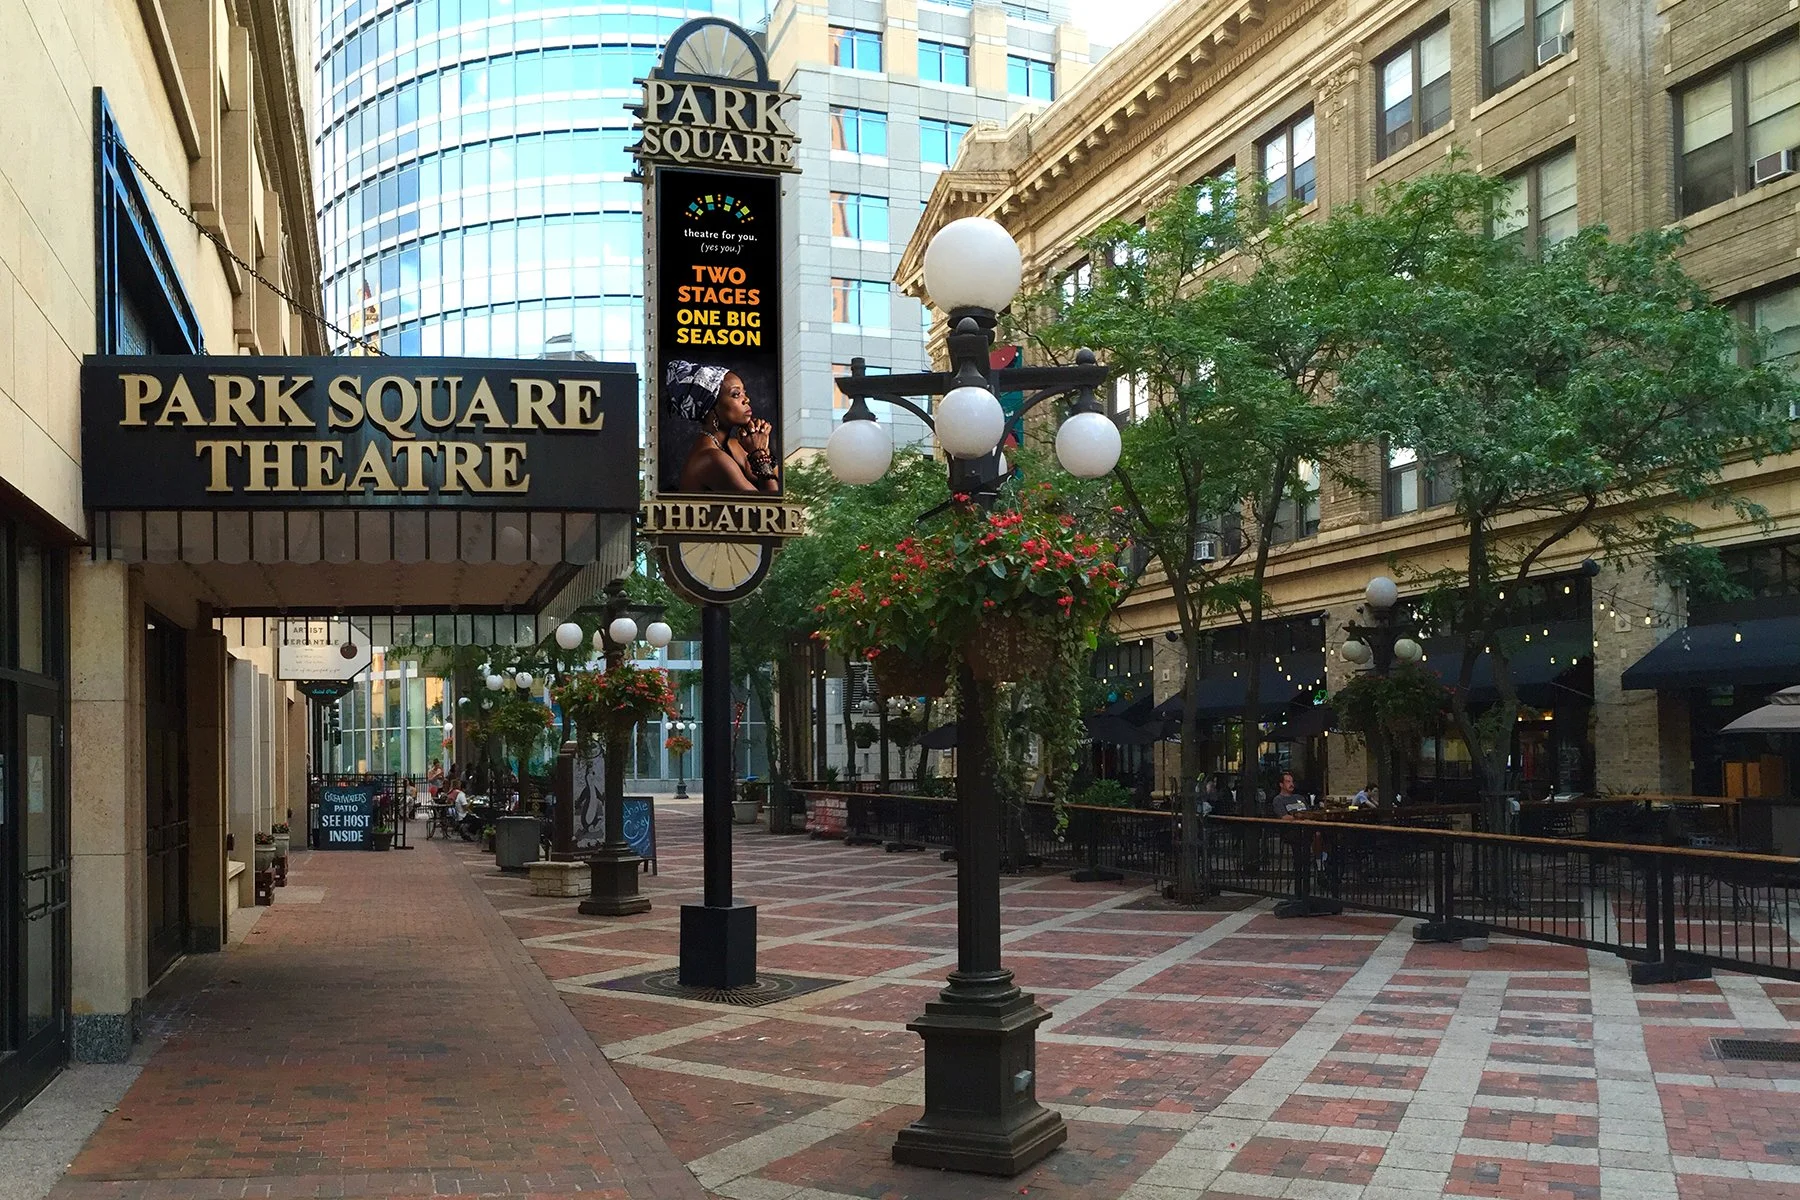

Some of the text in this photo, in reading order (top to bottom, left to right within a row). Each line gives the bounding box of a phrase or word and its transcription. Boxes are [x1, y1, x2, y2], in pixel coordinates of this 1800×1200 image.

[643, 80, 795, 136] PARK
[642, 126, 795, 168] SQUARE
[684, 228, 758, 242] theatre for you.
[700, 242, 719, 253] (yes
[692, 265, 746, 285] TWO
[678, 285, 760, 305] STAGES
[677, 309, 761, 328] ONE BIG
[677, 328, 761, 346] SEASON
[118, 373, 605, 439] PARK SQUARE
[195, 440, 531, 494] THEATRE
[640, 503, 804, 534] THEATRE
[334, 804, 358, 812] PATIO
[322, 815, 370, 827] SEE HOST
[329, 830, 364, 842] INSIDE
